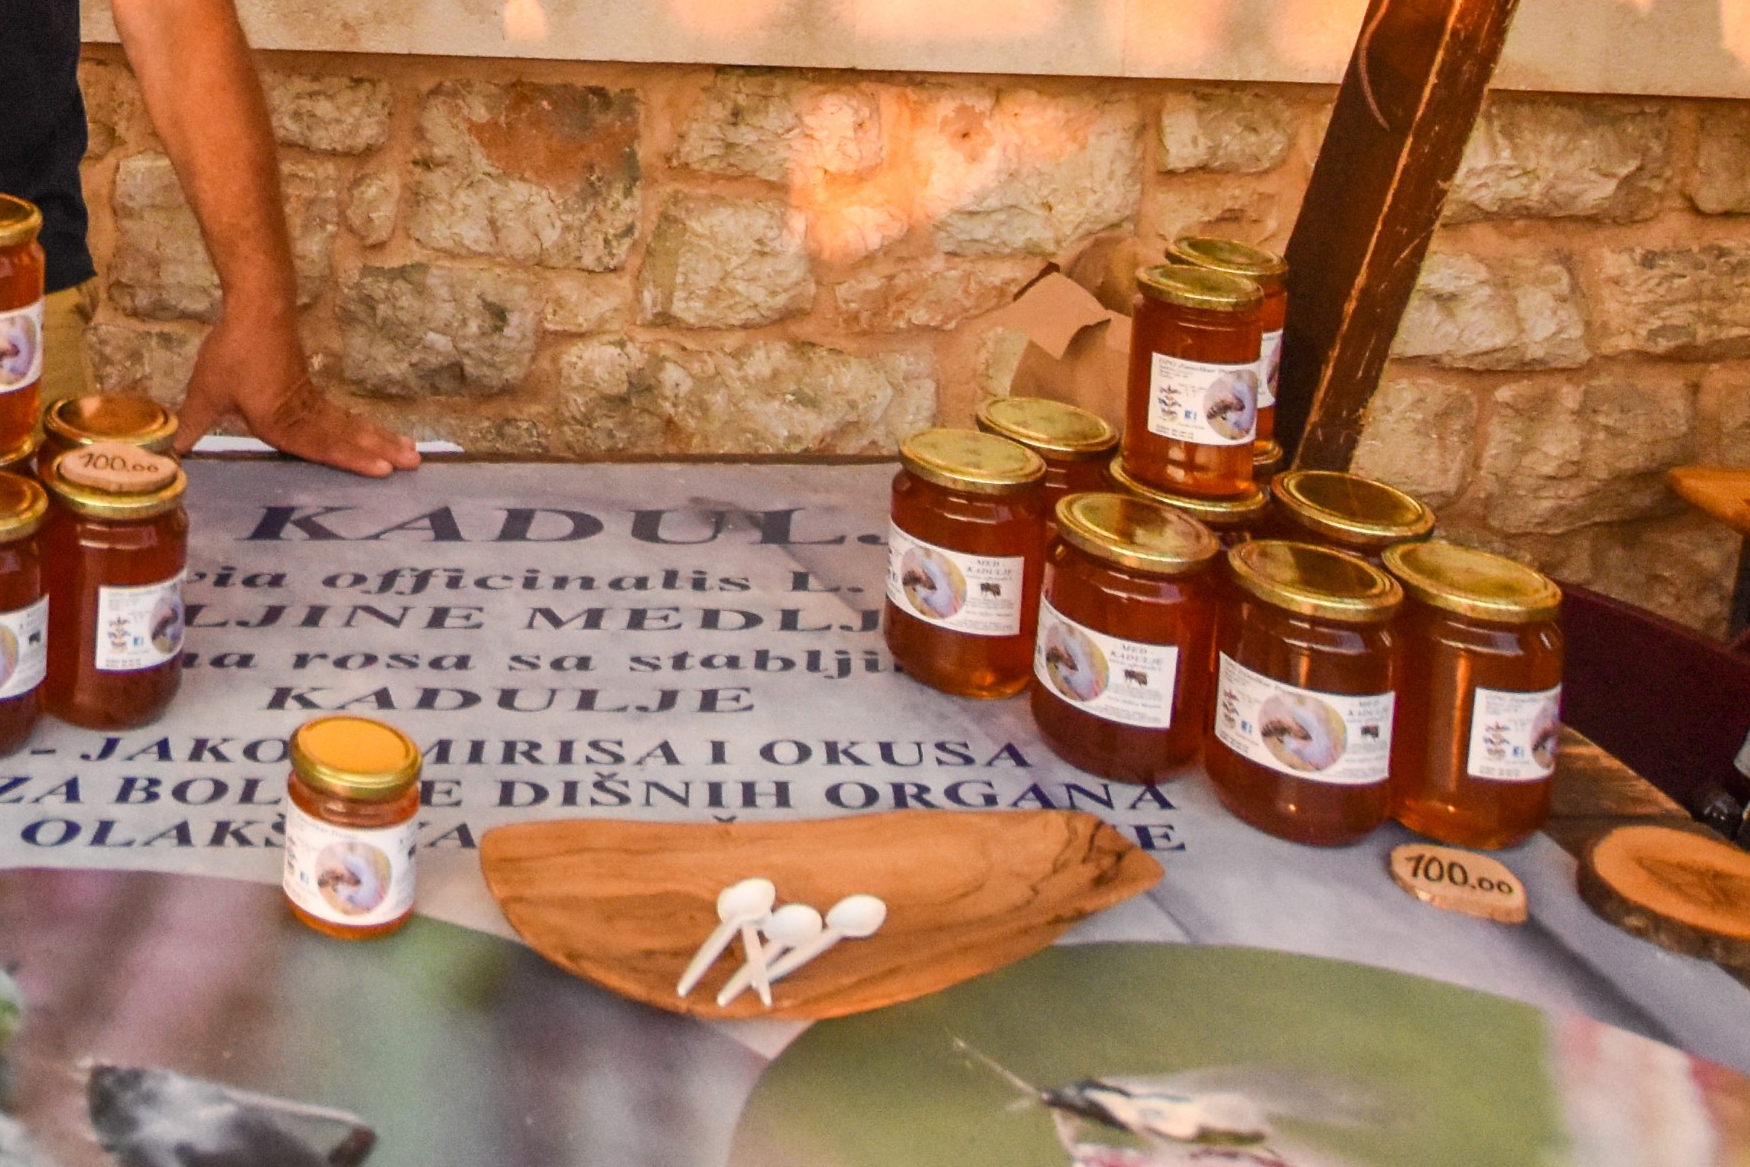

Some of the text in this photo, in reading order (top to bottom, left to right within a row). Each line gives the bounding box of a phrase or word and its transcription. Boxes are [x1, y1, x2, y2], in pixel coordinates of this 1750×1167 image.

[78, 452, 159, 473] 100.00
[235, 505, 888, 545] KADUL
[320, 567, 751, 595] officinalis
[785, 570, 865, 593] L.
[291, 652, 476, 671] rosa
[507, 654, 597, 672] sa
[628, 649, 898, 680] stablji
[258, 686, 755, 713] KADULJE
[709, 740, 734, 765] I
[758, 739, 1035, 769] OKUSA
[497, 771, 795, 809] DIŠNIH
[824, 780, 1177, 810] ORGANA
[1405, 853, 1515, 895] 100.00
